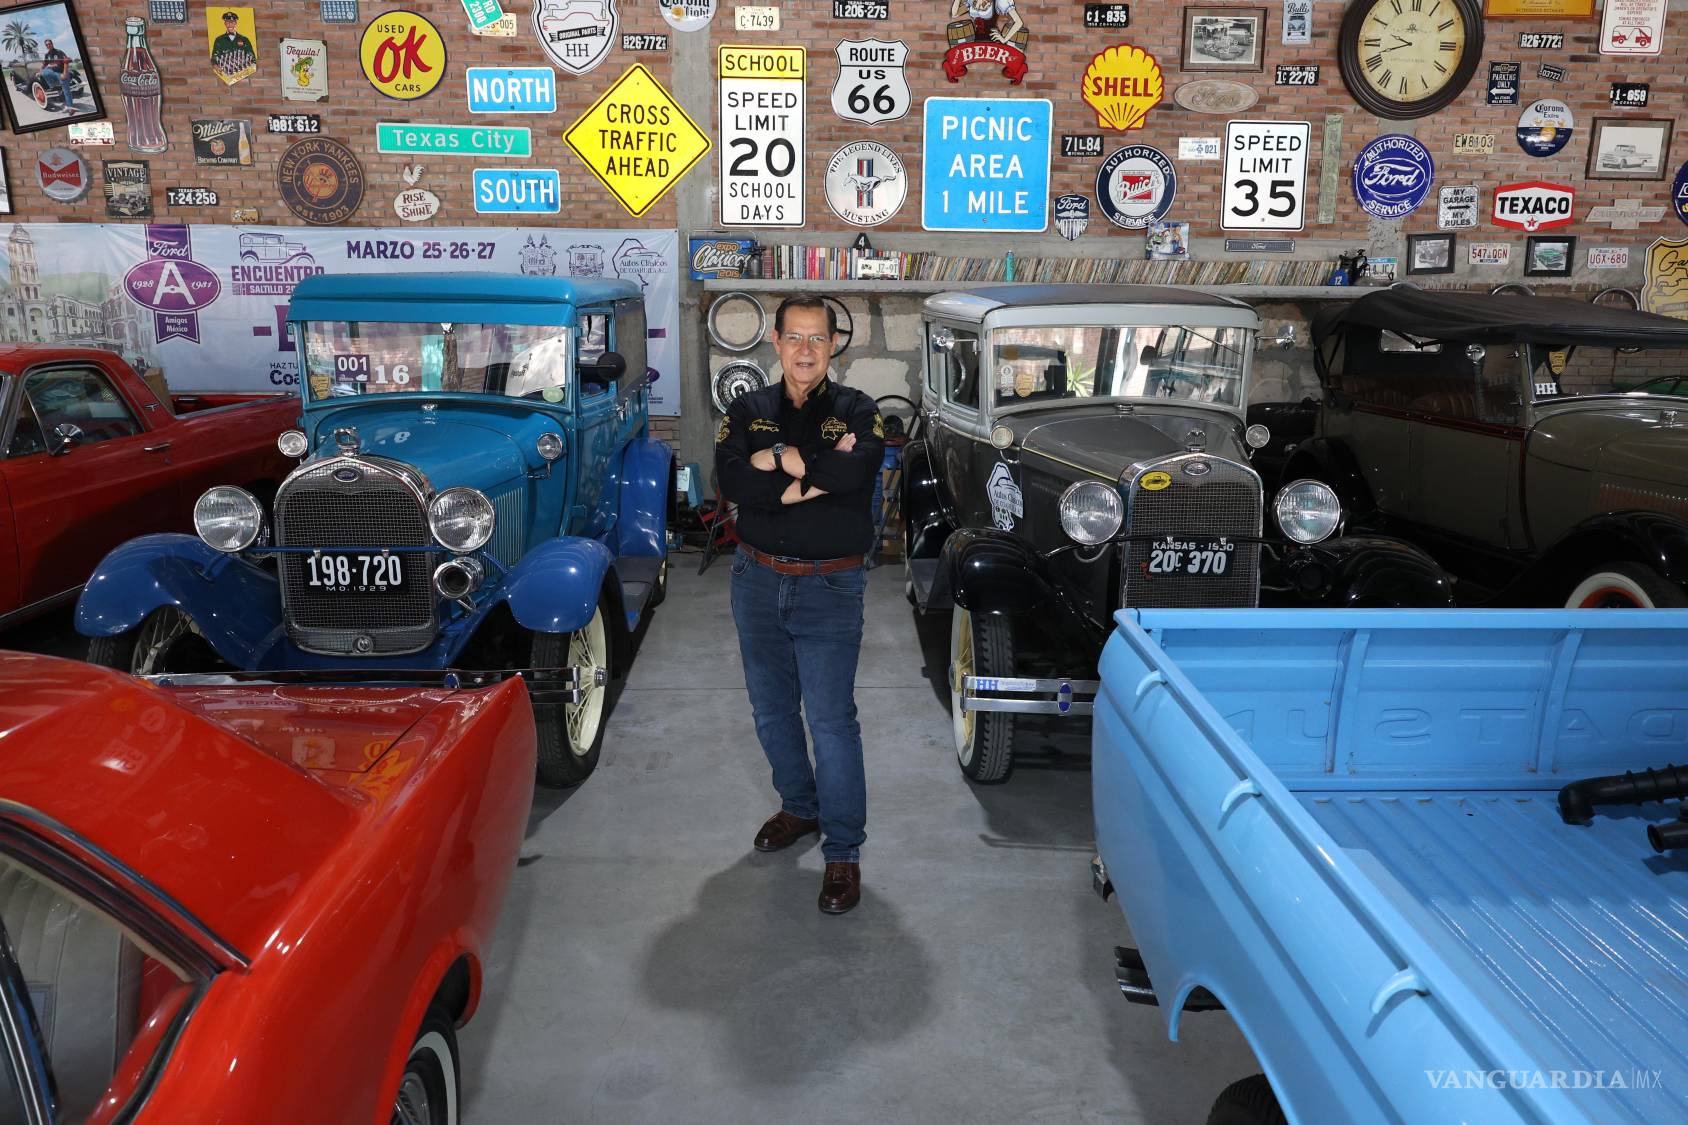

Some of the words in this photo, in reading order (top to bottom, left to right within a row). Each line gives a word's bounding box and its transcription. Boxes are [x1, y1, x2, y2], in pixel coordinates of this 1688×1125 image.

[470, 2, 488, 23] 2300
[482, 0, 496, 14] RD
[377, 24, 404, 34] USED
[559, 30, 581, 40] ORIGINAL
[581, 27, 597, 37] PARTS
[286, 45, 320, 57] Tequila!
[373, 26, 432, 83] OK
[566, 44, 589, 57] HH
[849, 48, 895, 62] ROUTE
[962, 46, 1009, 63] BEER
[725, 54, 800, 72] SCHOOL
[120, 72, 160, 86] Coca-Cola
[858, 70, 886, 80] US
[395, 84, 421, 92] CARS
[473, 78, 550, 103] NORTH
[1092, 76, 1154, 97] SHELL
[728, 92, 797, 108] SPEED
[848, 84, 895, 114] 66
[607, 104, 670, 125] CROSS
[1535, 104, 1564, 112] Corona
[735, 115, 789, 131] LIMIT
[942, 116, 1033, 141] PICNIC
[193, 123, 236, 141] Miller
[392, 130, 459, 147] Texas
[471, 129, 515, 153] City
[598, 129, 677, 152] TRAFFIC
[1234, 135, 1301, 151] SPEED
[729, 137, 796, 177] 20
[830, 156, 844, 174] THE
[843, 144, 880, 158] LEGEND
[881, 149, 902, 174] LIVES
[1364, 137, 1425, 166] AUTHORIZED
[283, 158, 296, 183] NEW
[292, 142, 320, 159] YORK
[323, 143, 359, 184] YANKEES
[606, 157, 669, 177] AHEAD
[948, 154, 1024, 178] AREA
[1106, 148, 1171, 175] AUTHORIZED
[1240, 158, 1292, 173] LIMIT
[107, 168, 145, 178] VINTAGE
[1364, 163, 1420, 186] Ford
[403, 192, 425, 204] RISE
[480, 179, 554, 203] SOUTH
[729, 182, 796, 199] SCHOOL
[1231, 179, 1296, 217] 35
[942, 190, 949, 214] 1
[968, 191, 1028, 214] MILE
[1057, 197, 1086, 210] Ford
[1368, 199, 1411, 215] SERVICE
[1443, 196, 1475, 204] GARAGE
[1498, 196, 1570, 214] TEXACO
[296, 205, 317, 220] est.
[322, 205, 349, 221] 1903
[402, 205, 433, 217] SHINE
[741, 205, 784, 220] DAYS
[842, 209, 890, 223] MUSTANG
[1113, 212, 1157, 226] SERVICE
[1055, 219, 1088, 240] MOTORS
[1445, 219, 1470, 227] RULES
[151, 240, 188, 256] Ford
[347, 240, 414, 259] MARZO
[858, 236, 865, 247] 4
[1472, 249, 1487, 258] 547
[132, 280, 154, 289] 1928
[152, 262, 196, 305] A
[250, 285, 283, 294] SALTILLO
[165, 316, 188, 324] Amigos
[338, 357, 368, 371] 001
[375, 366, 410, 384] 16
[1535, 382, 1558, 395] HH
[1153, 542, 1196, 551] KANSAS
[1187, 552, 1227, 574] 370
[976, 679, 999, 690] HH
